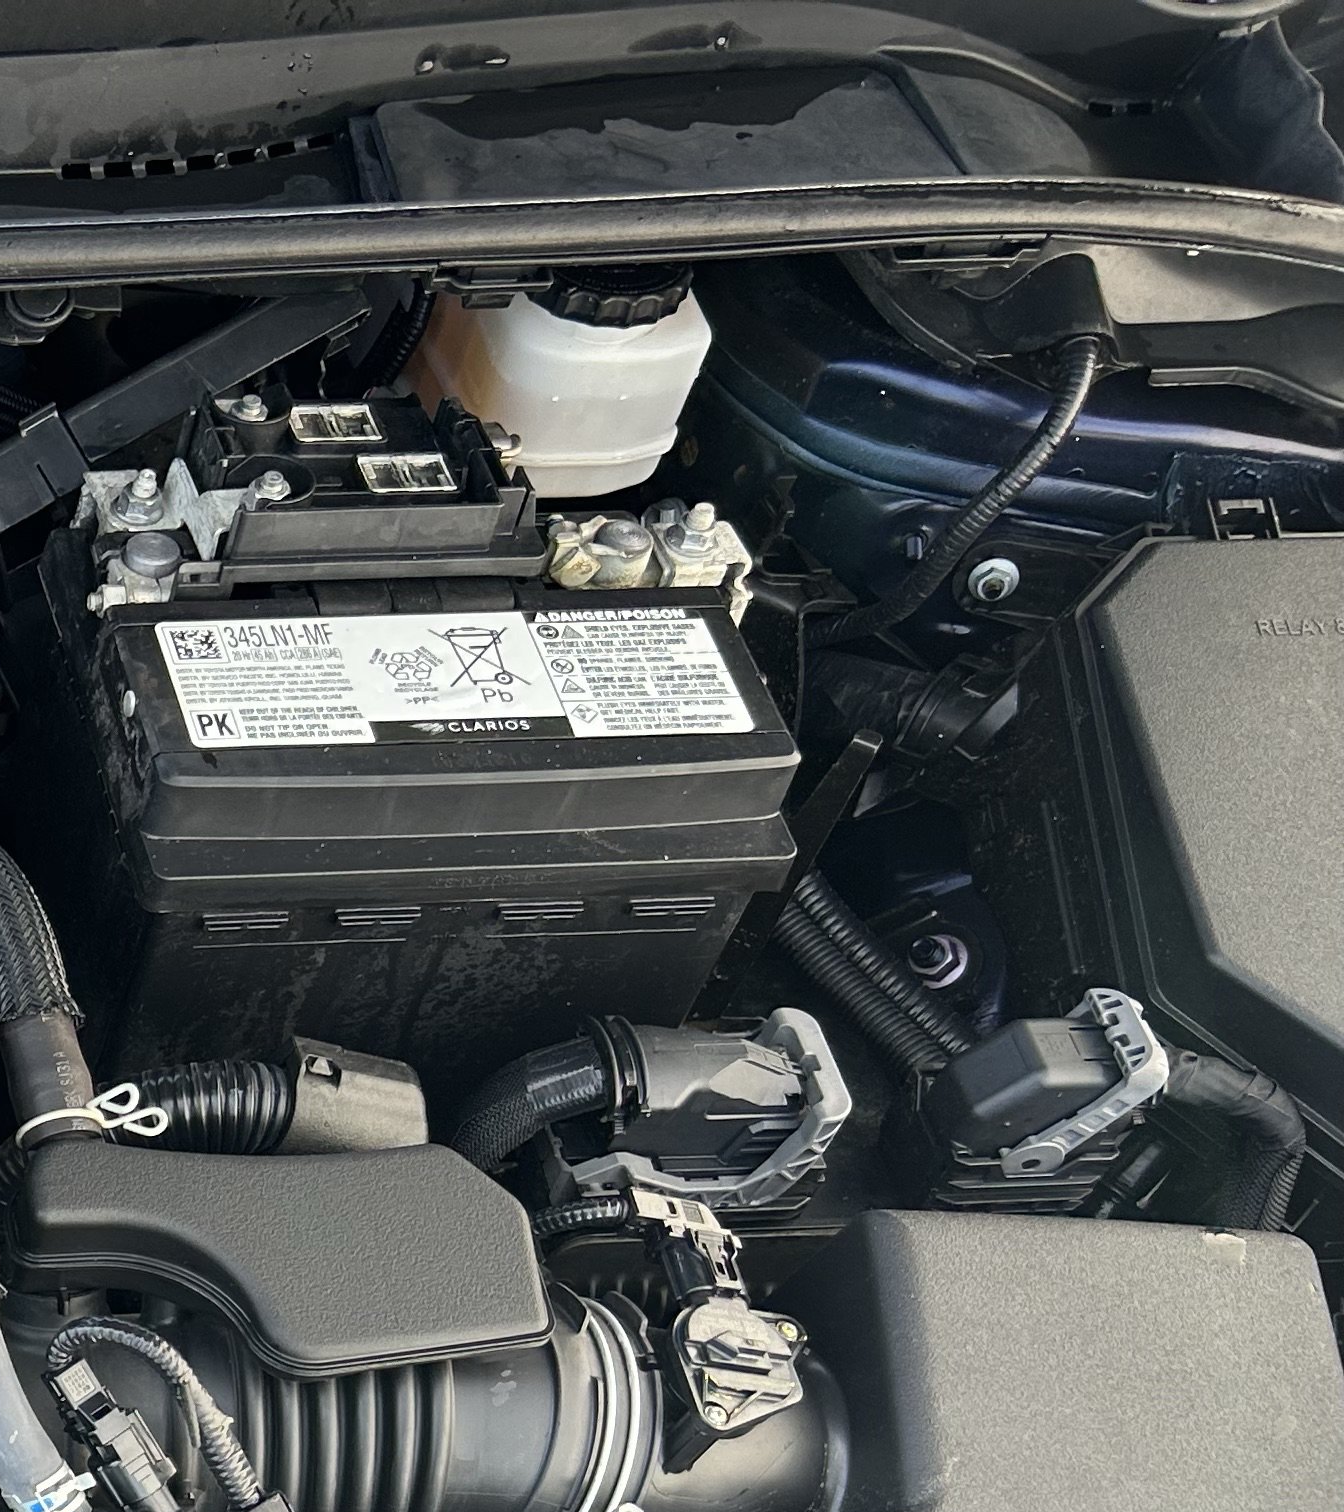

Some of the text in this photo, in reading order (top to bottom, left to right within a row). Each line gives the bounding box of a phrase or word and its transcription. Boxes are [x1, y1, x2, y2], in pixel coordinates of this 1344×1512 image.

[549, 608, 686, 622] DANGER/POISON
[224, 623, 333, 648] 345LN1-MF
[1254, 619, 1325, 636] RELAY
[481, 688, 513, 703] Pb
[197, 713, 235, 737] PK
[448, 720, 531, 733] CLARIOS
